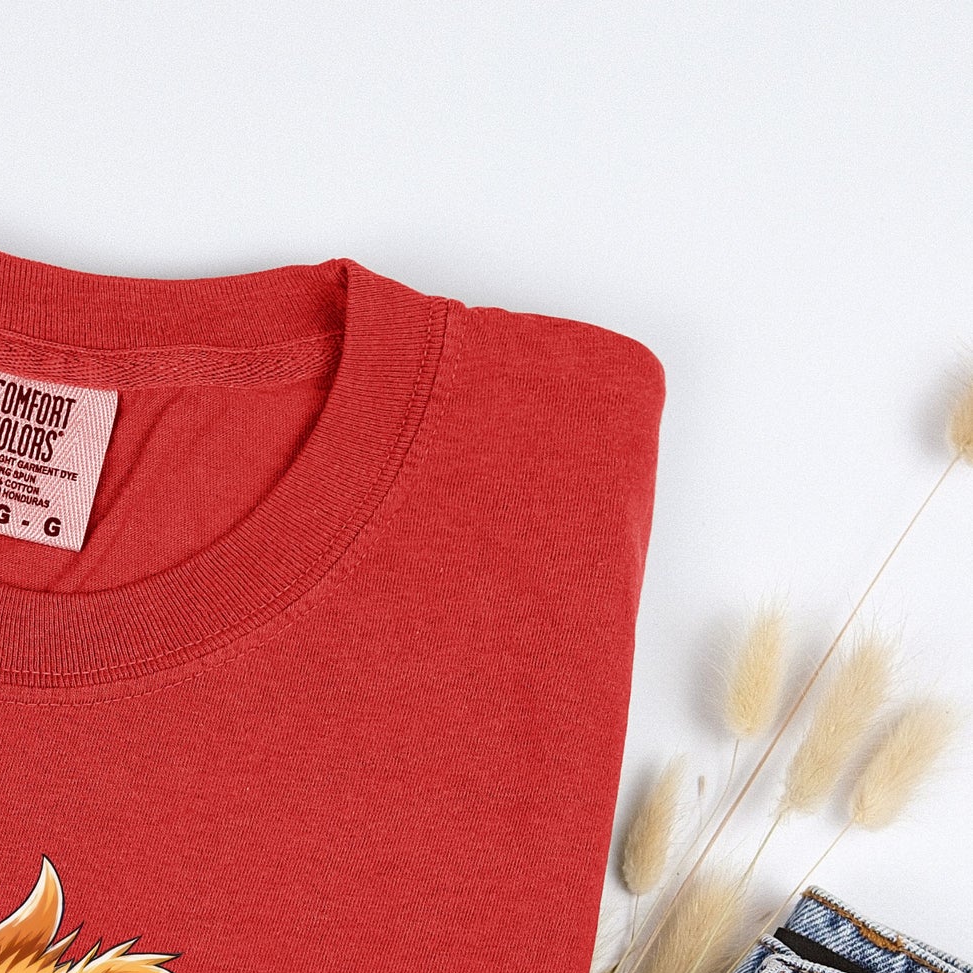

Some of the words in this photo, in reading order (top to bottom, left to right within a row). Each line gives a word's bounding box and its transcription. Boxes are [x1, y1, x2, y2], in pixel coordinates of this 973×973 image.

[12, 468, 37, 484] SPUN
[17, 459, 58, 478] GARMENT
[59, 470, 78, 481] DYE
[5, 479, 40, 495] COTTON
[2, 489, 50, 509] HONDURAS
[43, 517, 62, 537] G
